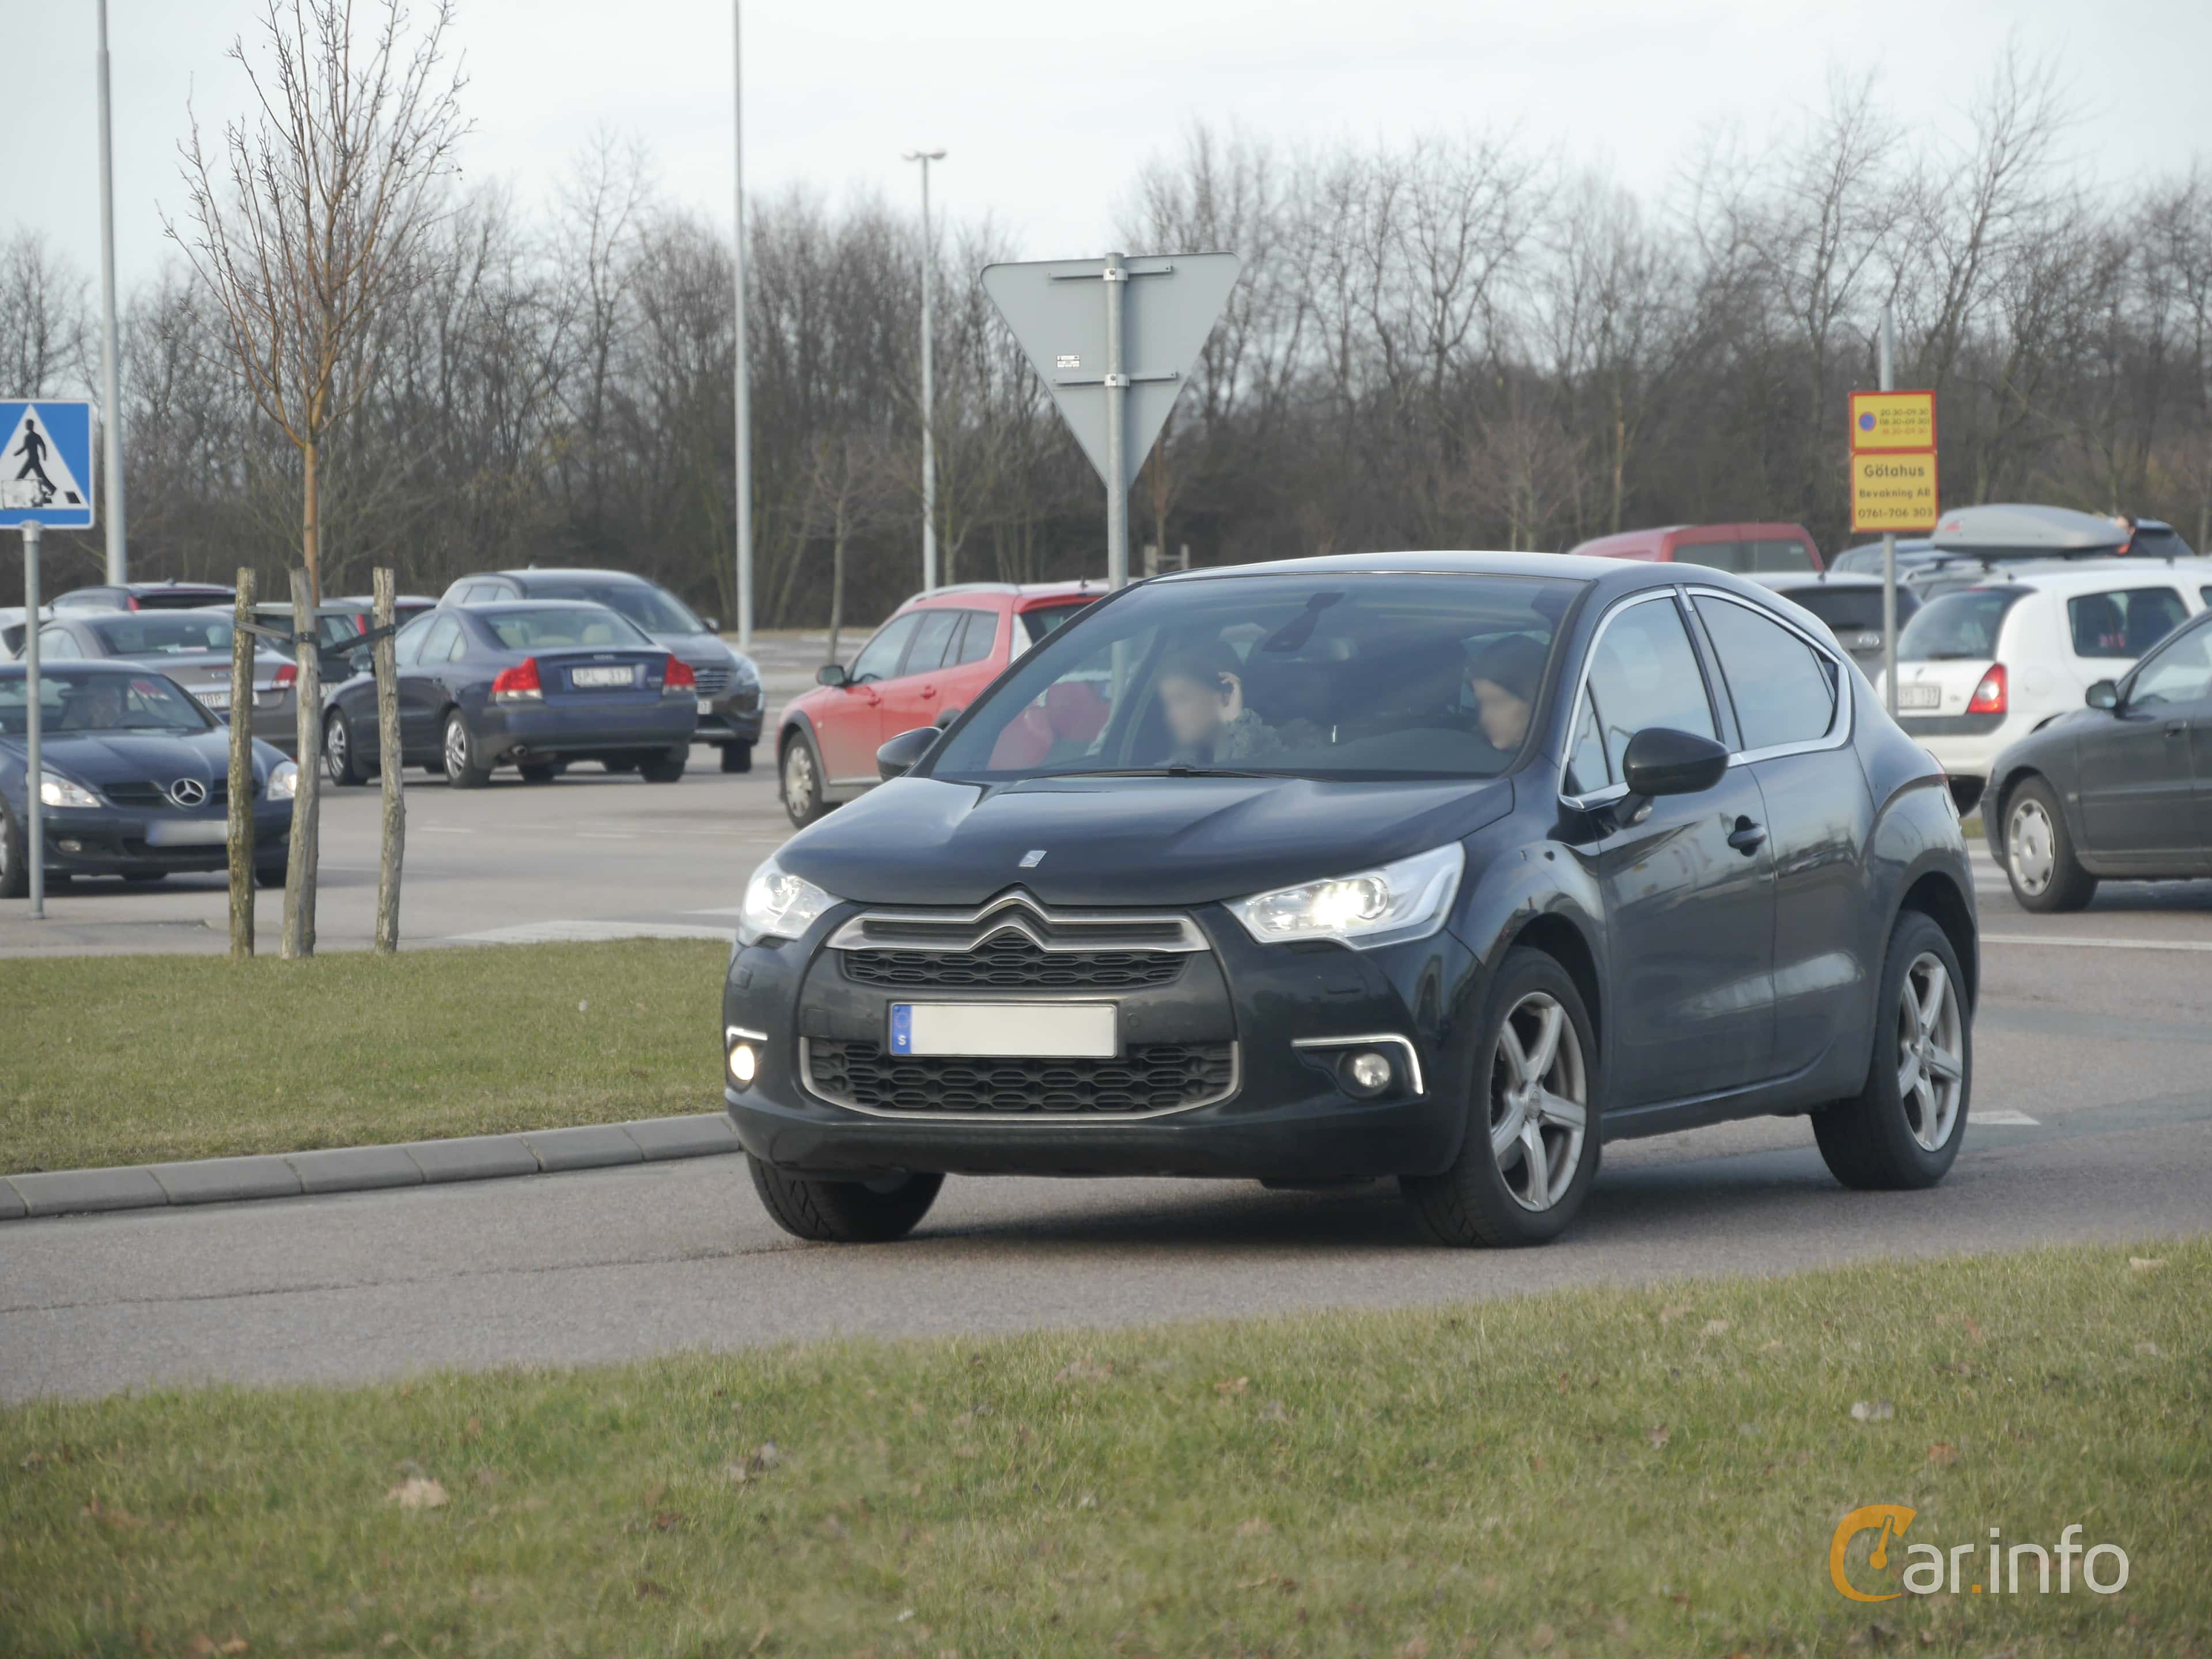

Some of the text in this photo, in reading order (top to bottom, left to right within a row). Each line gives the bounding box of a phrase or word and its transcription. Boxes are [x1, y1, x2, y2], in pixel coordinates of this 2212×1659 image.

[1864, 464, 1925, 478] Götahus
[1859, 487, 1931, 499] Bevakning AB
[898, 1035, 907, 1046] S
